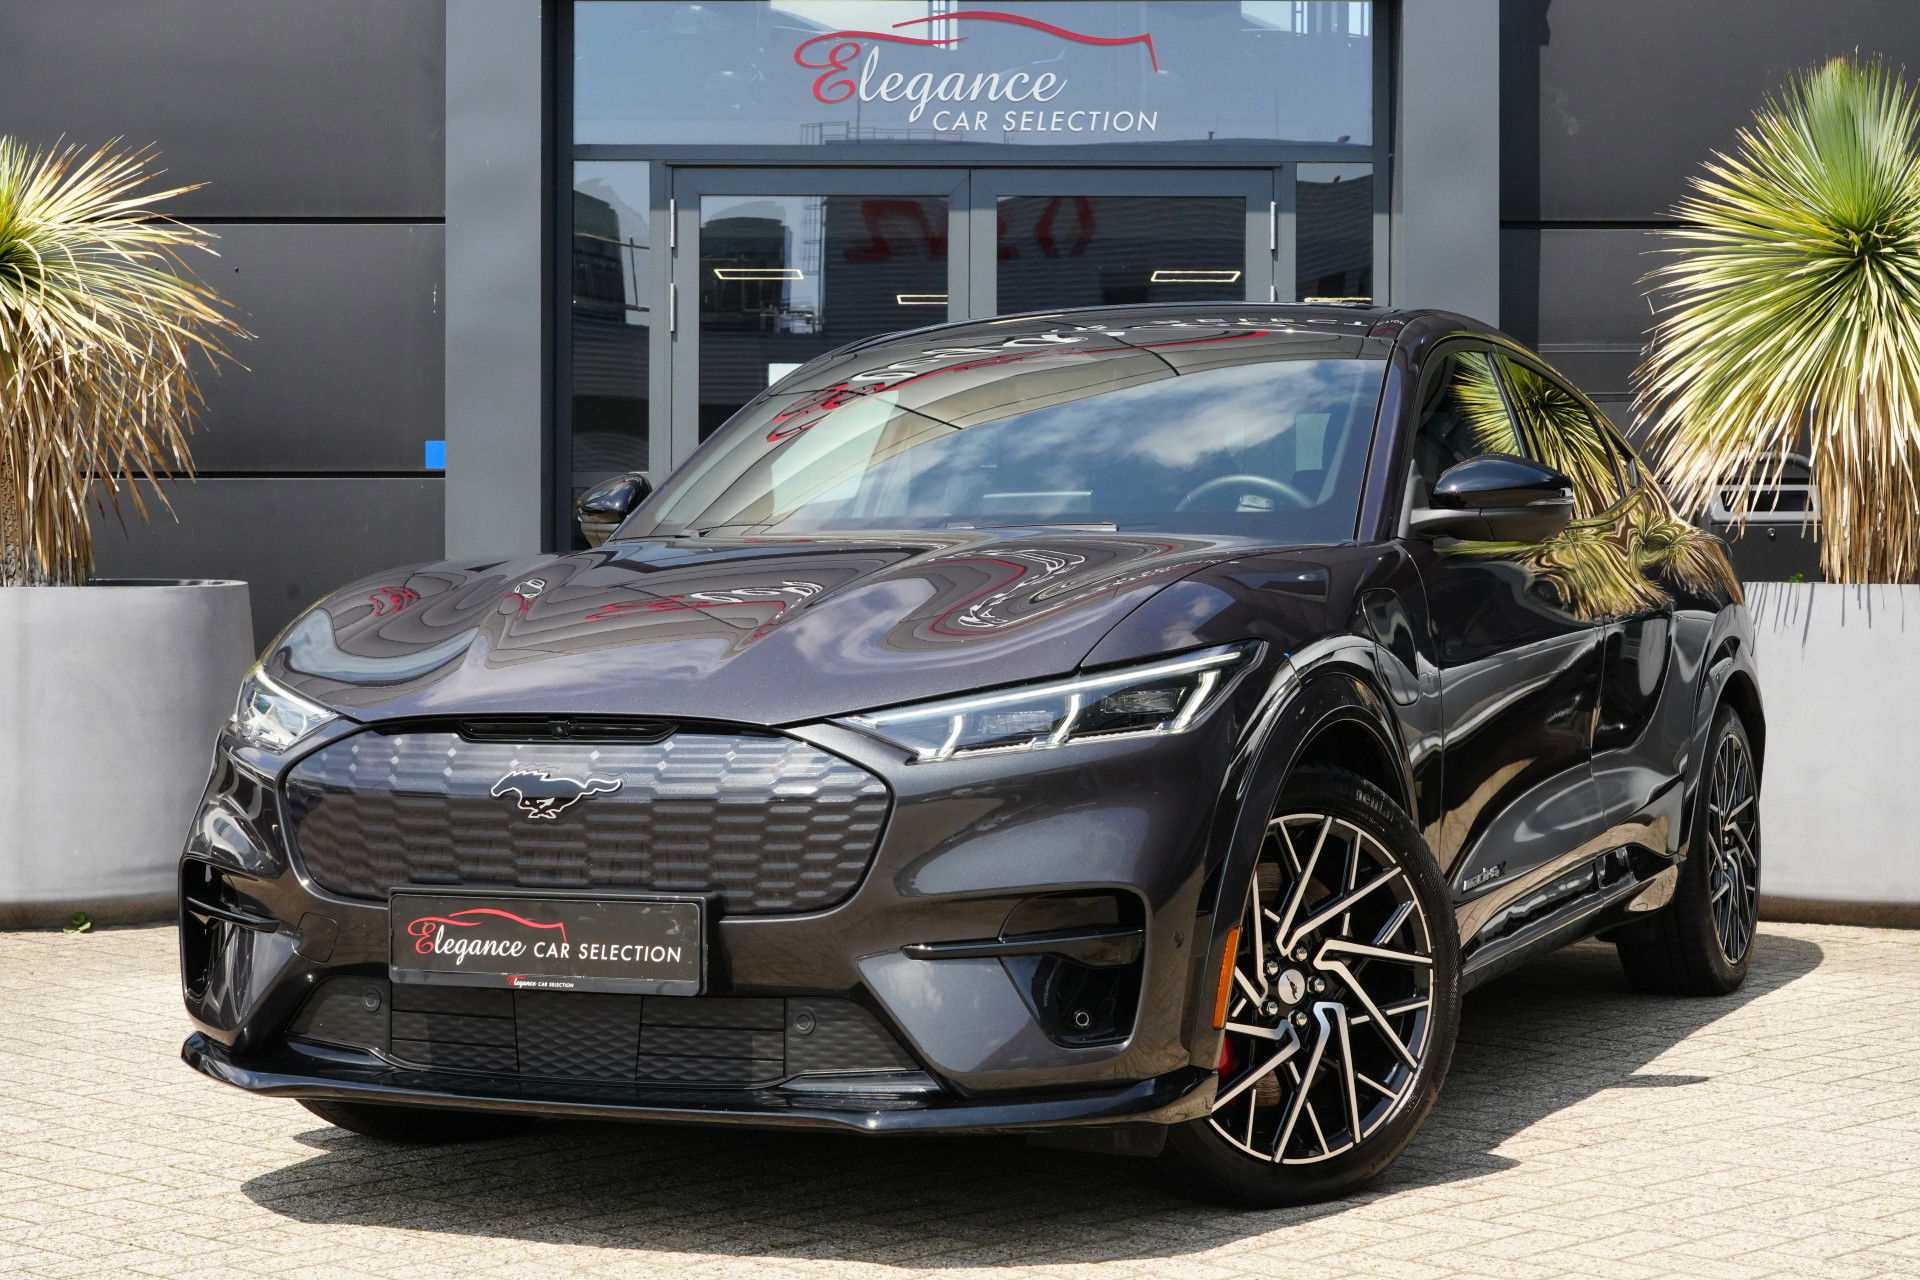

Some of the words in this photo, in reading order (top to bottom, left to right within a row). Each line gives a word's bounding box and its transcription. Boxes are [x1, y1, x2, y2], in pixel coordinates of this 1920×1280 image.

[794, 30, 1068, 123] Elegance
[932, 110, 988, 132] CAR
[1002, 110, 1159, 132] SELECTION
[407, 917, 526, 965] Elegance
[533, 941, 570, 959] CAR
[578, 943, 682, 963] SELECTION
